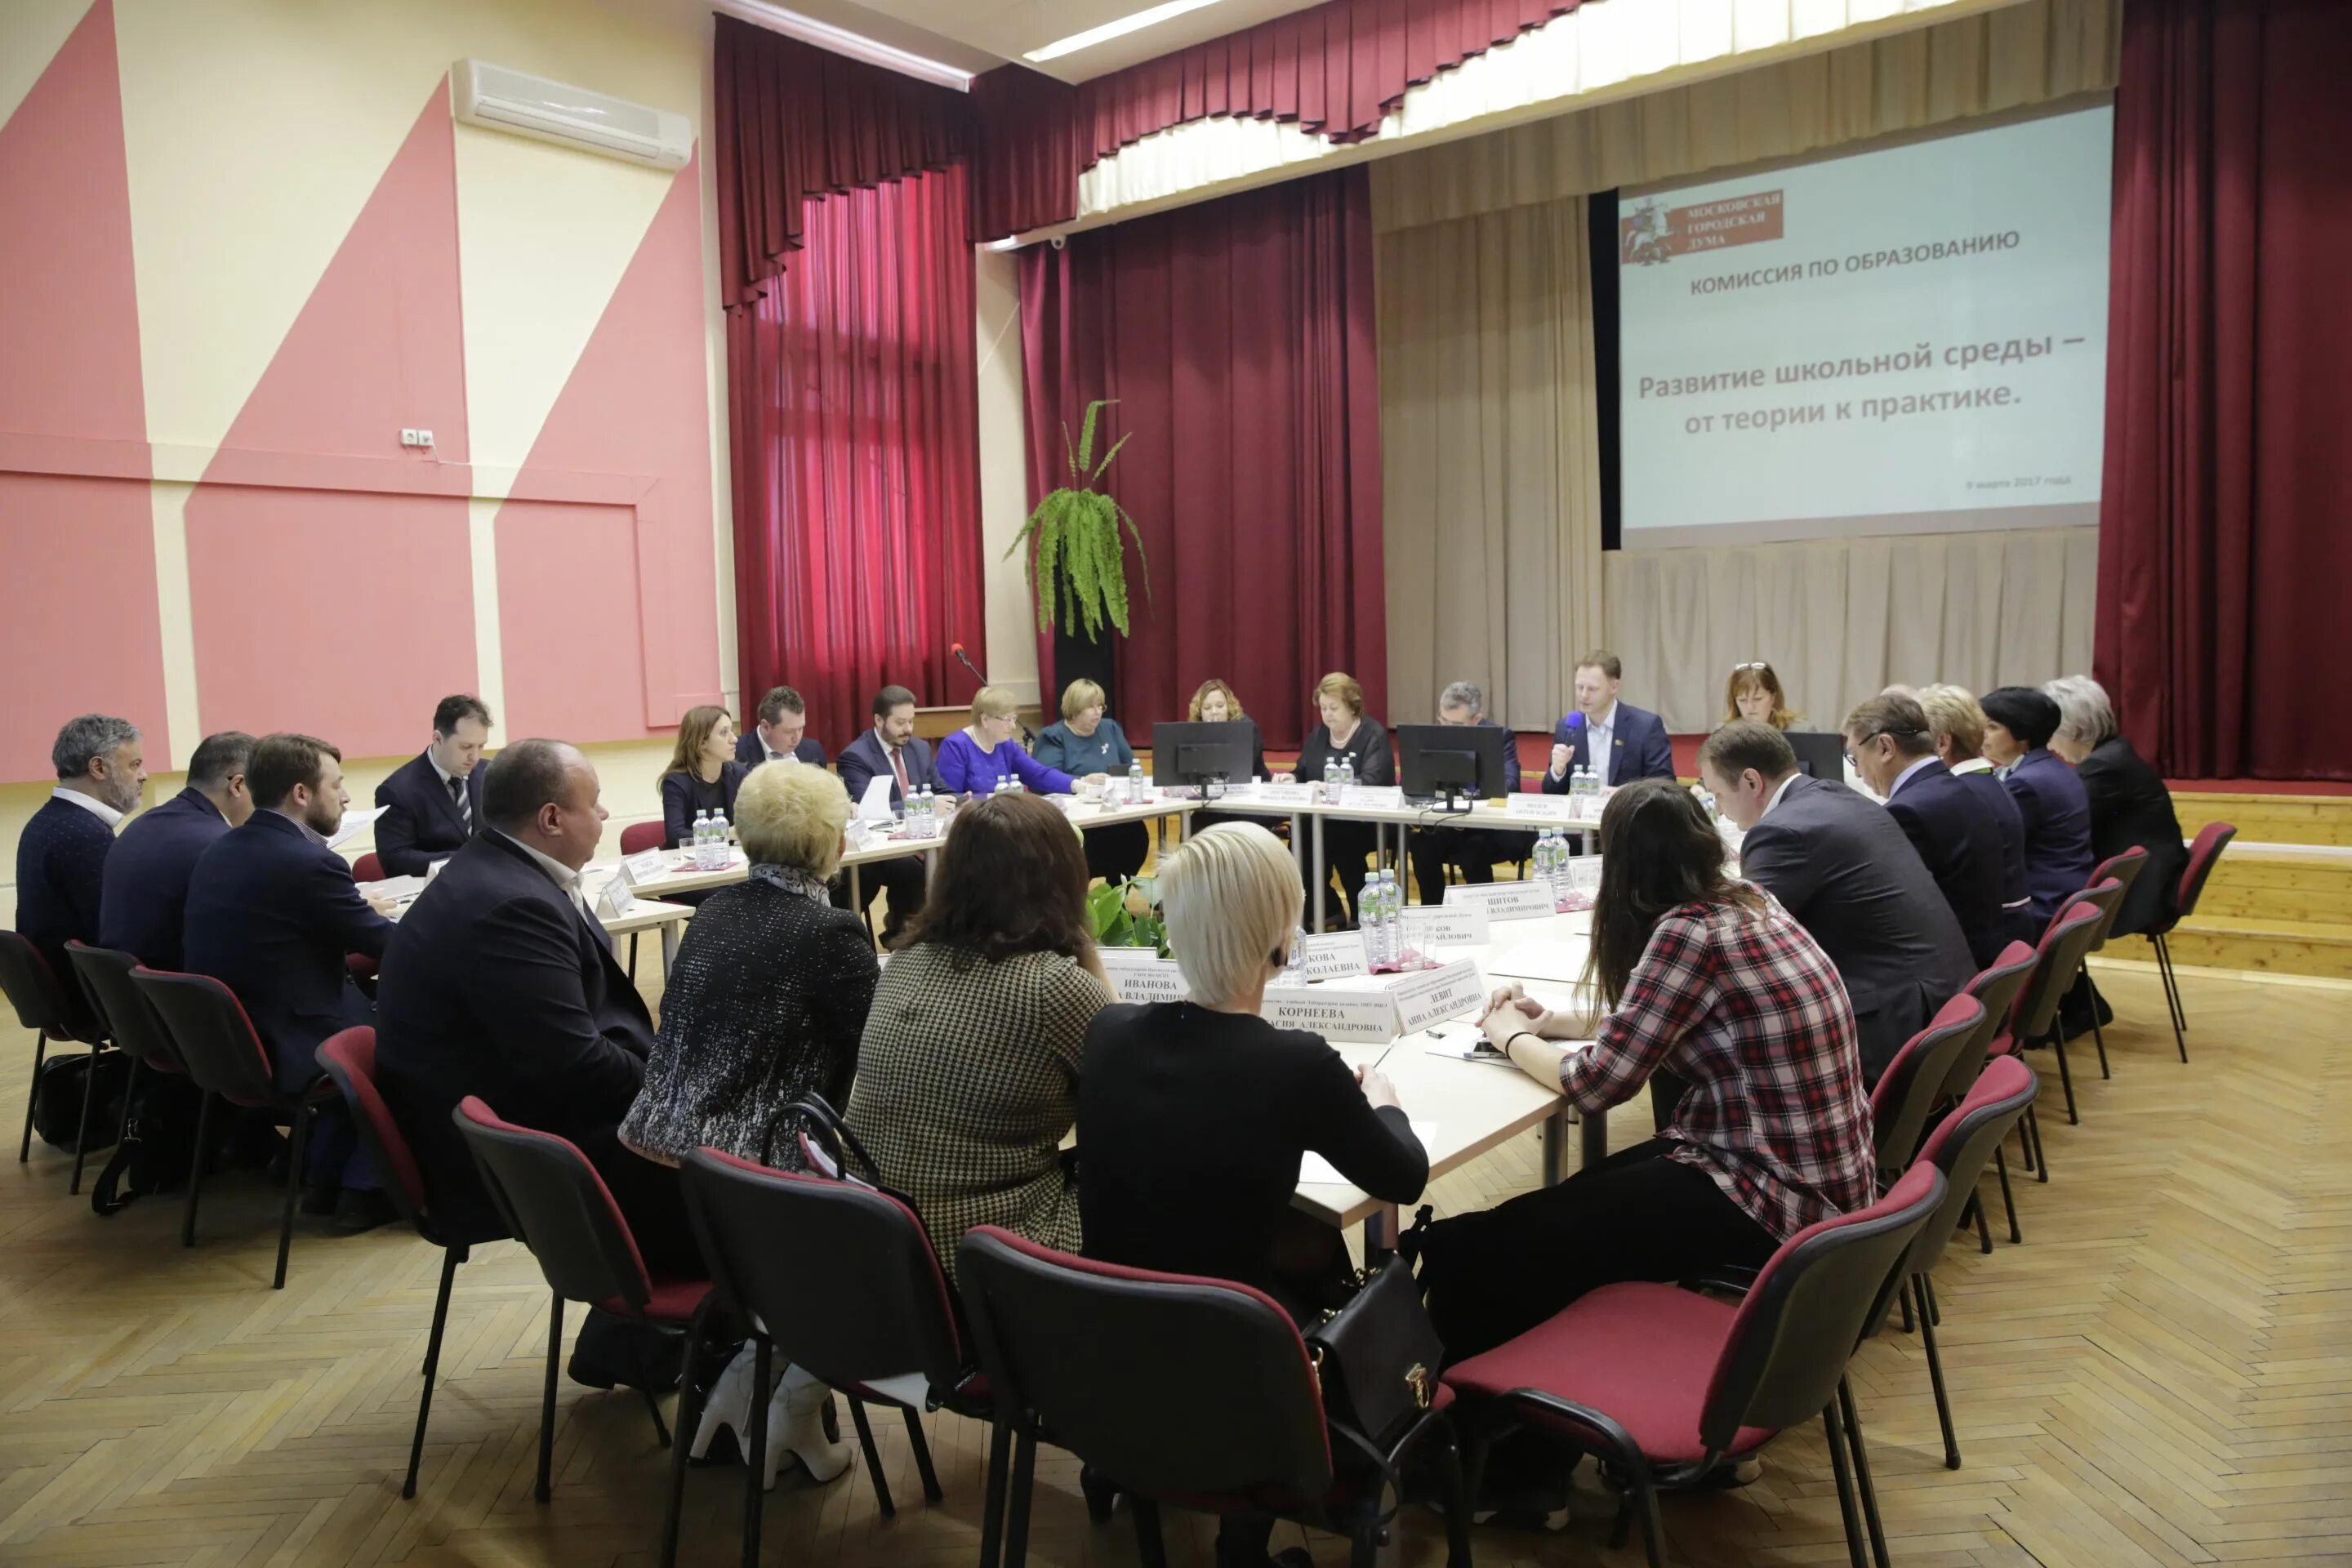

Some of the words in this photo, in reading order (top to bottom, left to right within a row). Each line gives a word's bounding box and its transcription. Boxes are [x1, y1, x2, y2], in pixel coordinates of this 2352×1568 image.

[1687, 193, 1780, 219] МОСКОВСКАЯ
[1687, 212, 1766, 234] ГОРОДСКАЯ
[1686, 235, 1726, 251] ДУМА
[1690, 264, 1802, 296] КОМИССИЯ
[1809, 259, 1838, 278] ПО
[1846, 230, 2020, 273] ОБРАЗОВАНИЮ
[1640, 368, 1766, 399] Развитие
[1775, 342, 1932, 384] школьной
[1944, 336, 2051, 370] среды
[1685, 415, 1714, 434] от
[1722, 403, 1824, 432] теории
[1836, 401, 1851, 421] к
[1862, 385, 2021, 421] практике.
[1125, 979, 1177, 990] ИВАНОВА
[1431, 988, 1453, 1004] ЛЕВИТ
[1279, 1006, 1345, 1018] КОРНЕЕВА
[1408, 1013, 1428, 1026] АННА
[1428, 992, 1482, 1018] АЛЕКСАНДРОВНА
[1300, 1022, 1383, 1031] АЛЕКСАНДРОВНА
